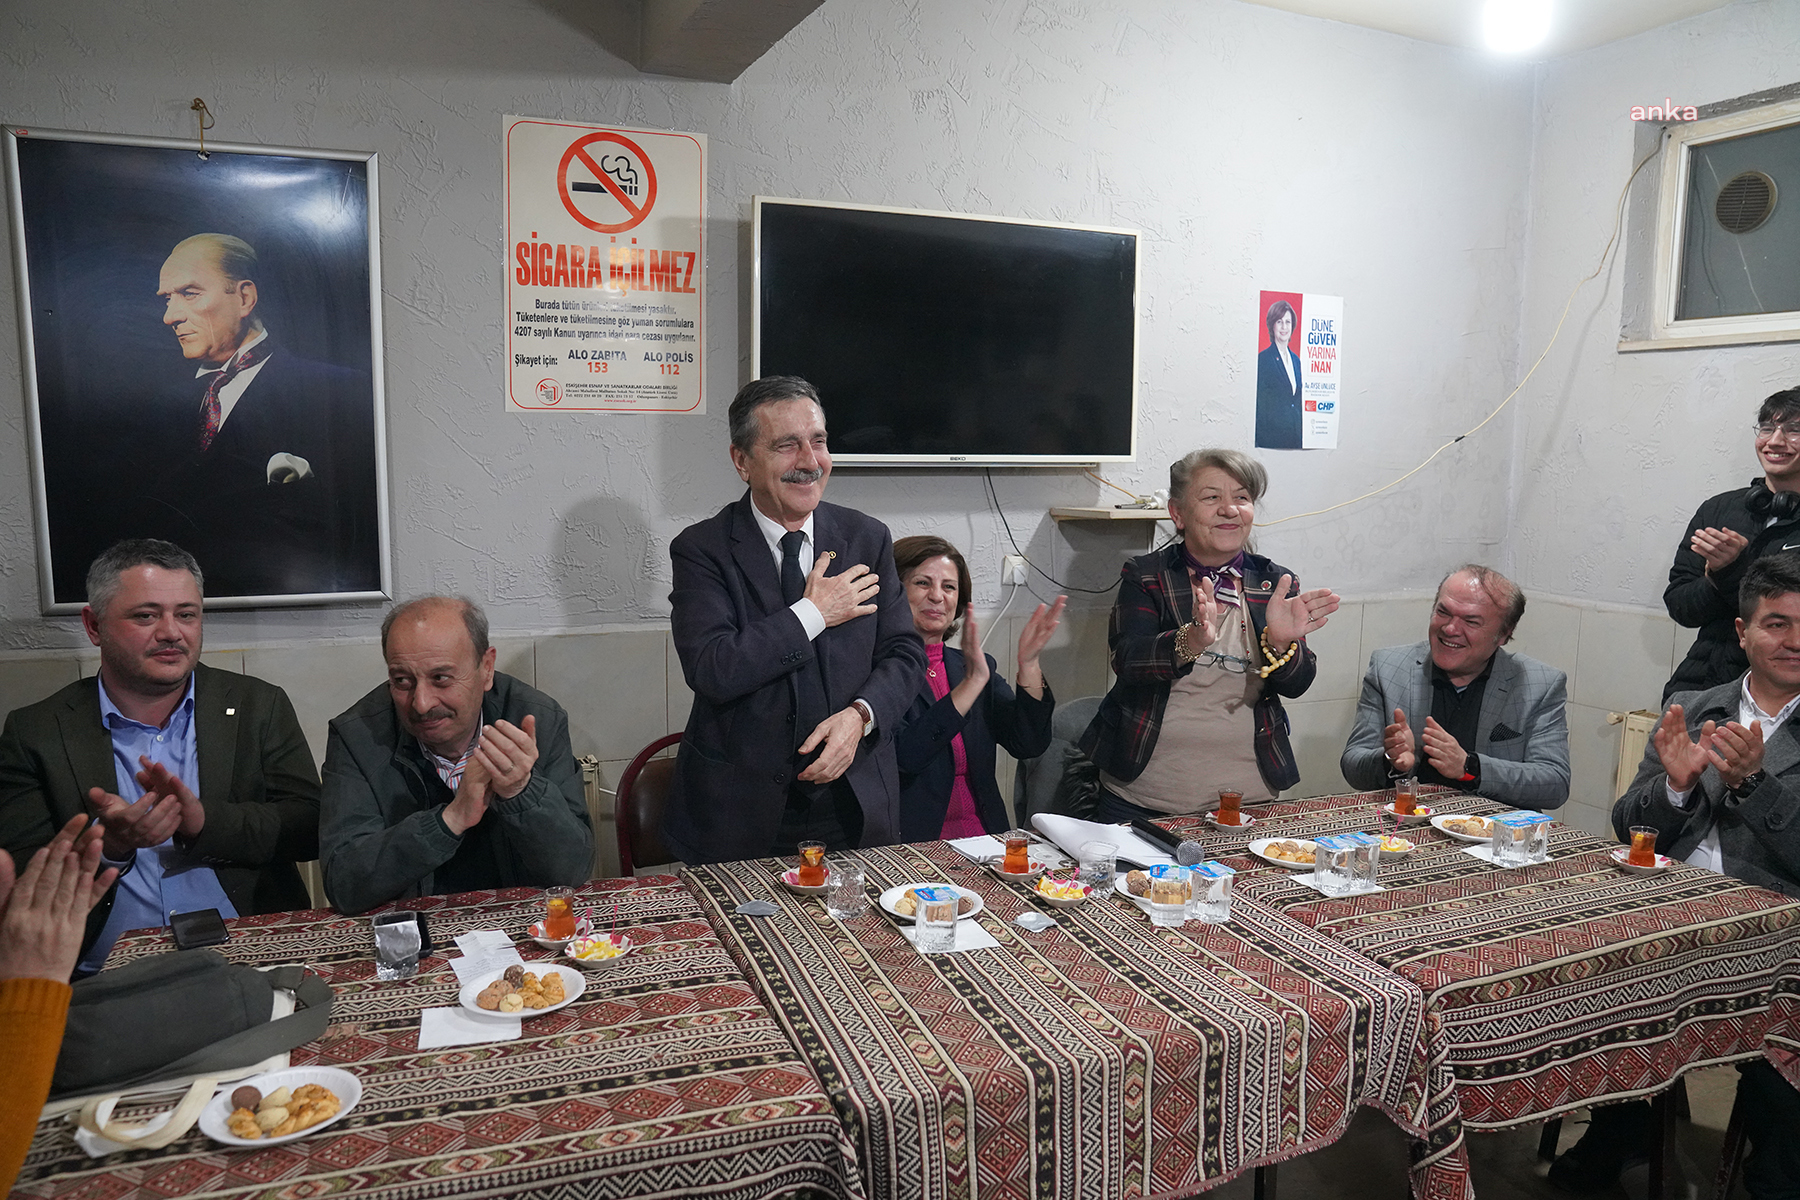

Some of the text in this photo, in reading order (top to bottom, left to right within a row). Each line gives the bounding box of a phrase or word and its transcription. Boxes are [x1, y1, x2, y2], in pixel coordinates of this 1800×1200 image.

[516, 231, 696, 297] SİGARA İÇİLMEZ
[535, 299, 560, 310] Burada
[562, 300, 580, 311] tütün
[648, 304, 677, 316] yasaktır.
[516, 312, 694, 329] Tüketenlere ve tüketilmesine göz yuman sorumlulara
[1312, 318, 1334, 333] DÜNE
[514, 326, 532, 337] 4207
[533, 327, 553, 340] sayılı
[554, 327, 576, 338] Kanun
[577, 329, 607, 341] uyarınca
[608, 330, 624, 339] idari
[641, 332, 663, 341] cezası
[1308, 332, 1337, 346] GÜVEN
[568, 349, 627, 361] ALO ZABITA
[643, 351, 694, 363] ALO POLİS
[1307, 346, 1337, 360] YARINA
[515, 354, 558, 368] Şikayet için:
[587, 362, 608, 373] 153
[660, 364, 680, 375] 112
[1317, 402, 1334, 411] CHP
